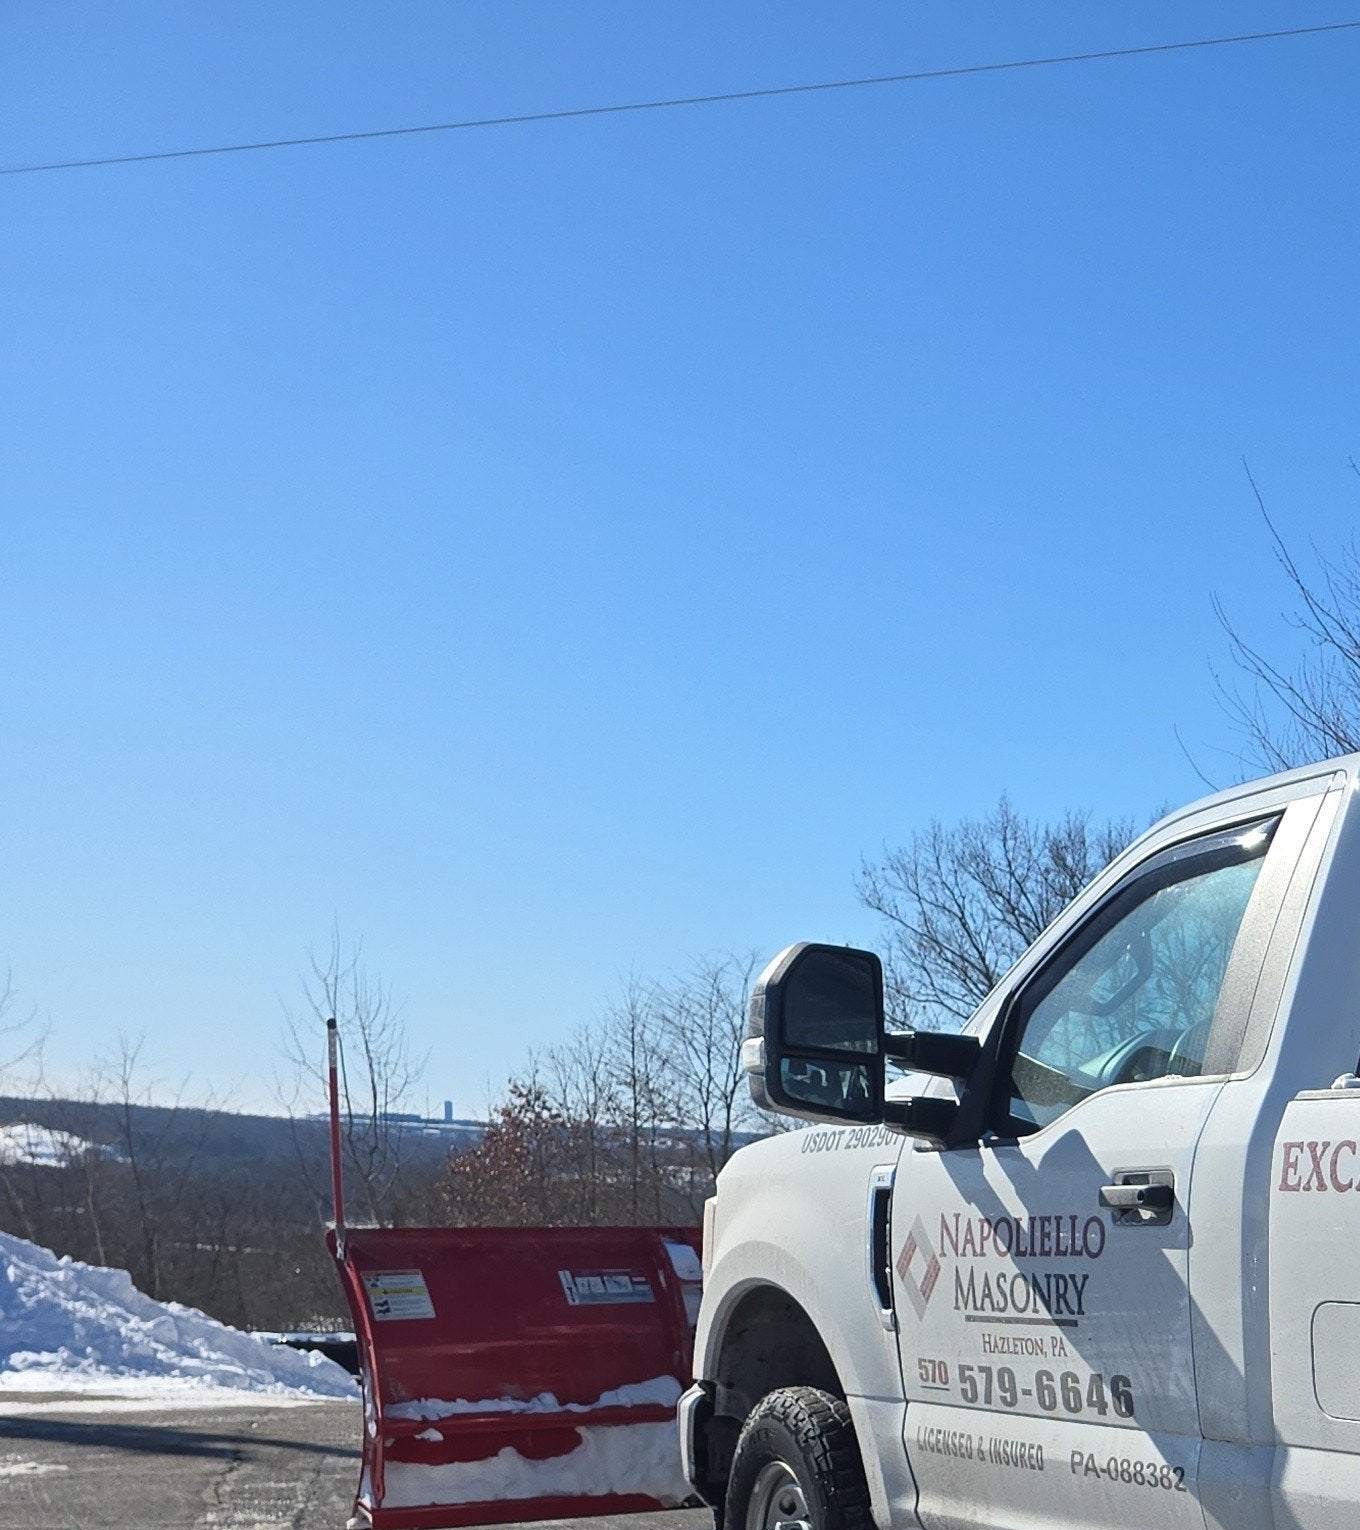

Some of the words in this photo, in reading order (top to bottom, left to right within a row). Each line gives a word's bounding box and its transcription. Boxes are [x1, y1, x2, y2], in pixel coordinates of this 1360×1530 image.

[801, 1129, 846, 1154] USDOT
[938, 1211, 1107, 1261] NAPOLIELLO
[953, 1264, 1089, 1316] MASONRY
[981, 1333, 1046, 1358] HAZLETON,
[1050, 1334, 1069, 1359] PA
[917, 1357, 950, 1386] 570
[958, 1363, 1135, 1419] 579-6646
[916, 1424, 976, 1461] LICENSED
[976, 1435, 986, 1463] &
[988, 1435, 1045, 1472] INSURED
[1070, 1448, 1188, 1493] PA-088382
